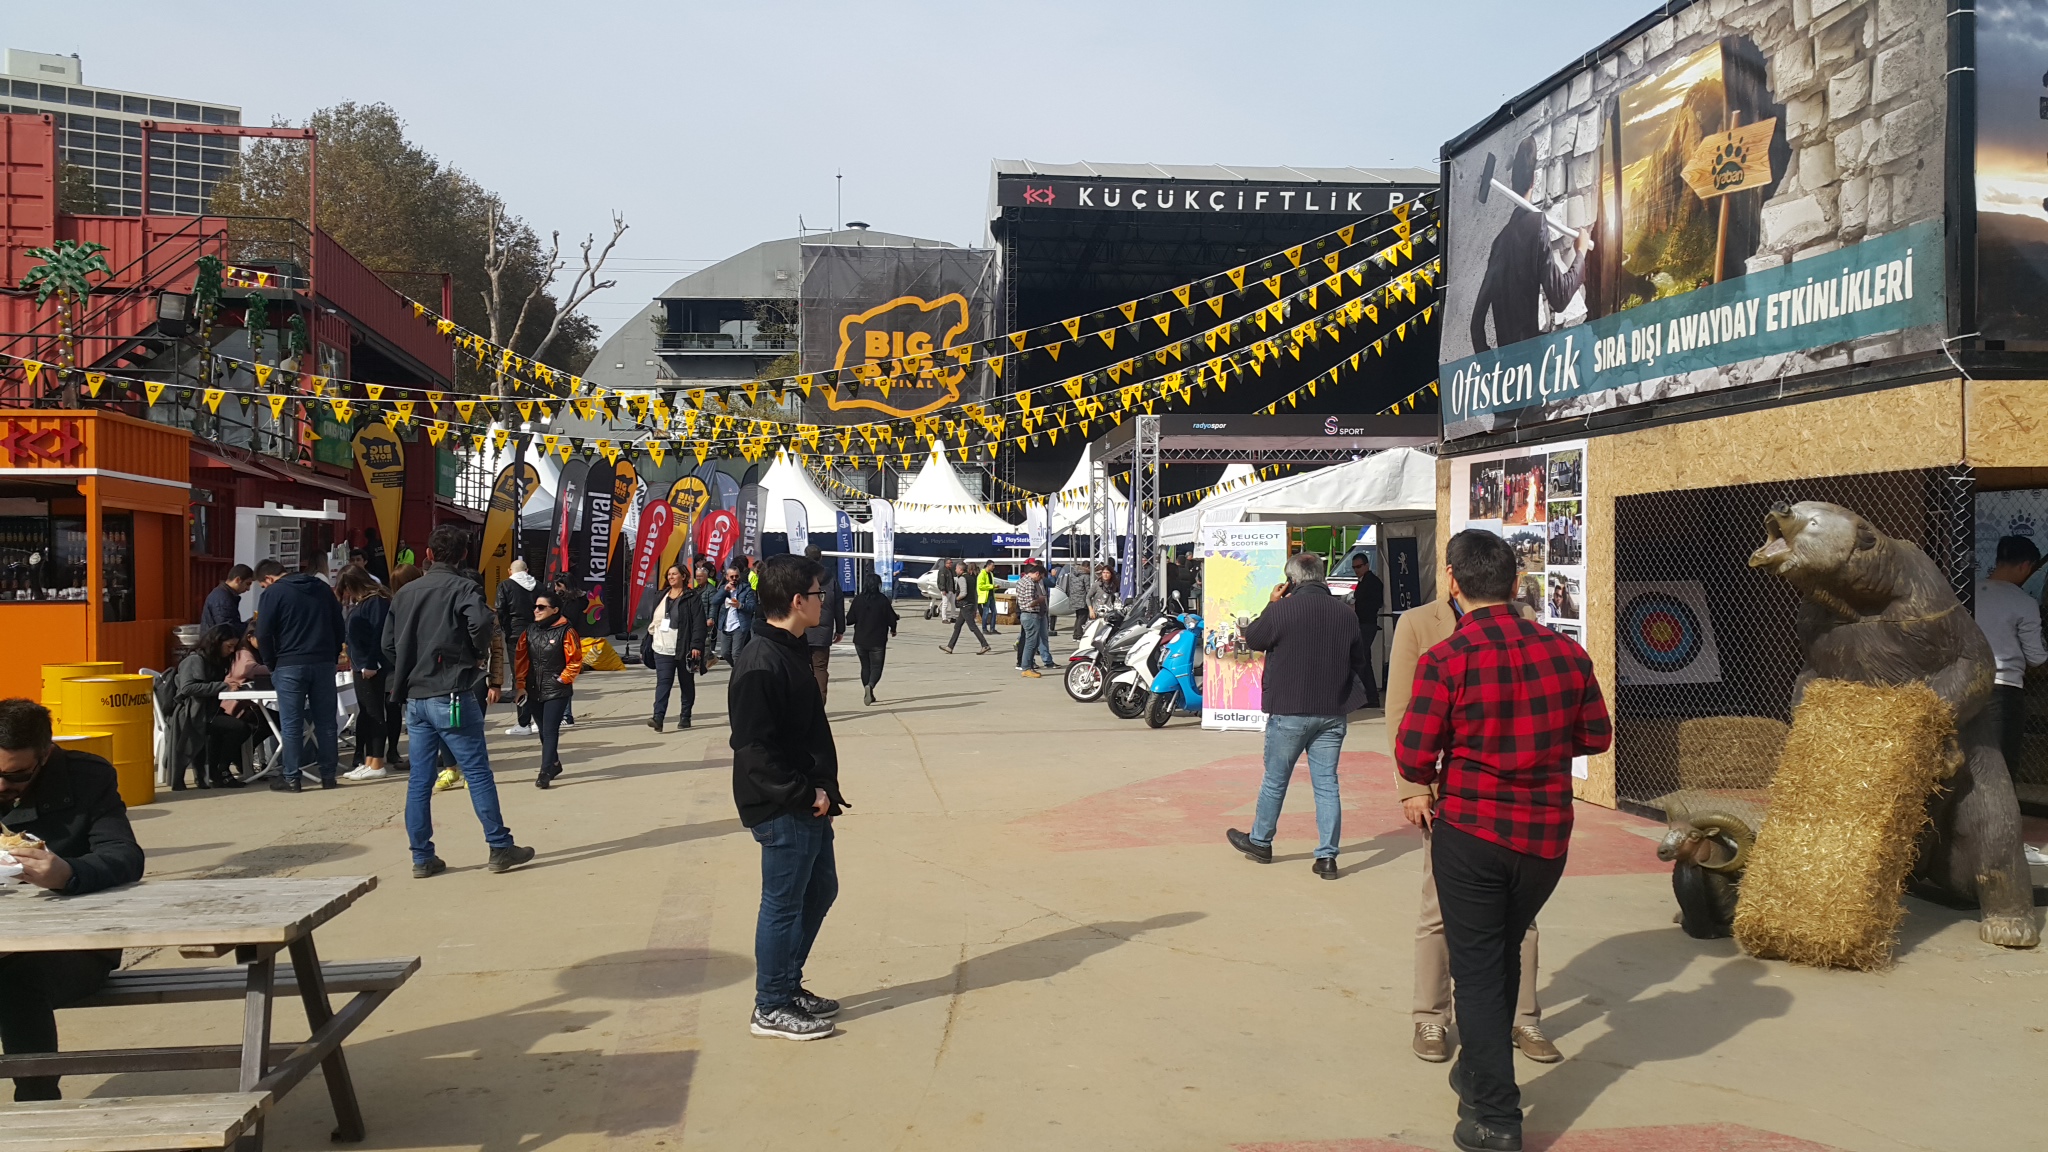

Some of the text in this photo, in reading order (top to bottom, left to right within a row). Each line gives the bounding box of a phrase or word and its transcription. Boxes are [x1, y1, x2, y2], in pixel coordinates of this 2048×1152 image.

[1715, 169, 1743, 189] yaban
[865, 330, 934, 359] BIG
[1451, 248, 1914, 424] Ofisten Çık SIRA DIŞI AWAYDAY ETKİNLİKLERİ
[1192, 422, 1227, 431] radyospor
[583, 491, 612, 582] karnaval
[636, 504, 667, 587] Canon
[742, 501, 758, 555] STREET
